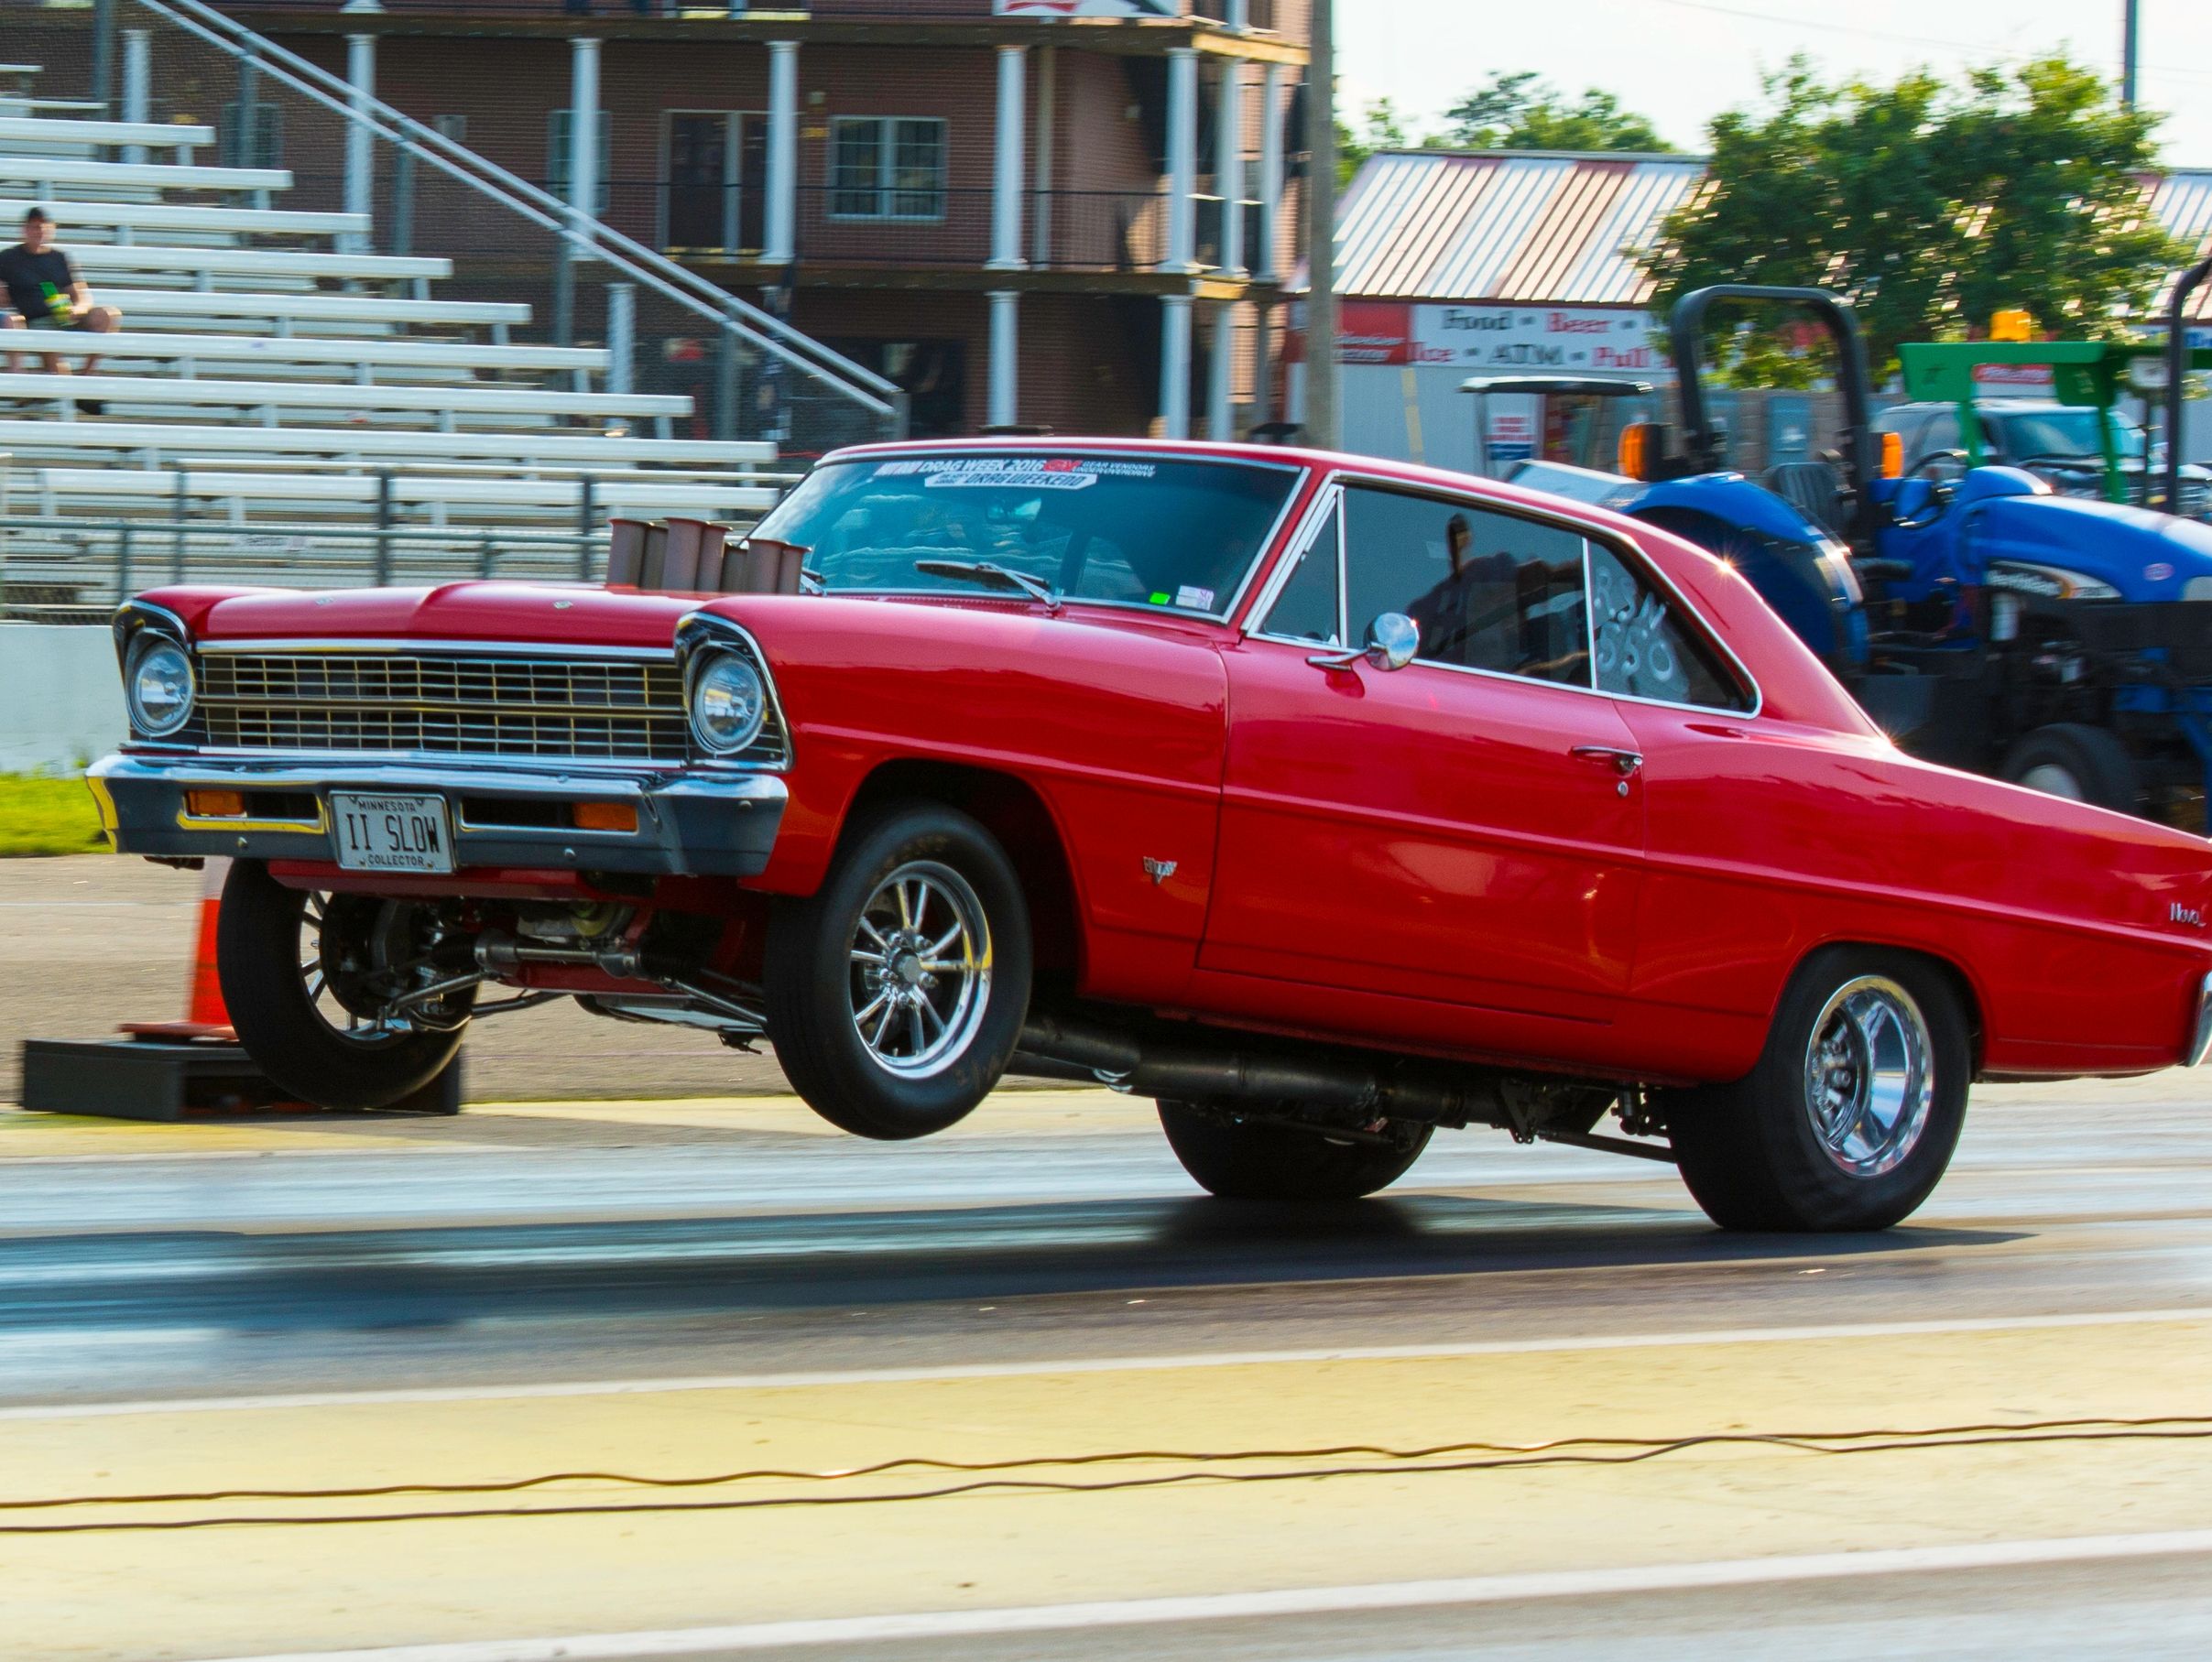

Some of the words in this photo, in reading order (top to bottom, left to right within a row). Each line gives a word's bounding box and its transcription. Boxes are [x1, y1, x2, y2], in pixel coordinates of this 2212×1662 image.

[1443, 310, 1512, 330] Food
[1546, 312, 1610, 332] Beer
[1407, 342, 1455, 362] Ice
[1487, 344, 1564, 364] ATM
[920, 460, 964, 473] DRAG
[962, 459, 1008, 472] WEEK
[1008, 459, 1045, 472] 2016
[1007, 473, 1086, 486] WEEKEND
[358, 801, 416, 812] MINNESOTA
[385, 814, 440, 853] SLOW
[368, 854, 424, 866] COLLECTOR
[2170, 902, 2200, 925] Nova
